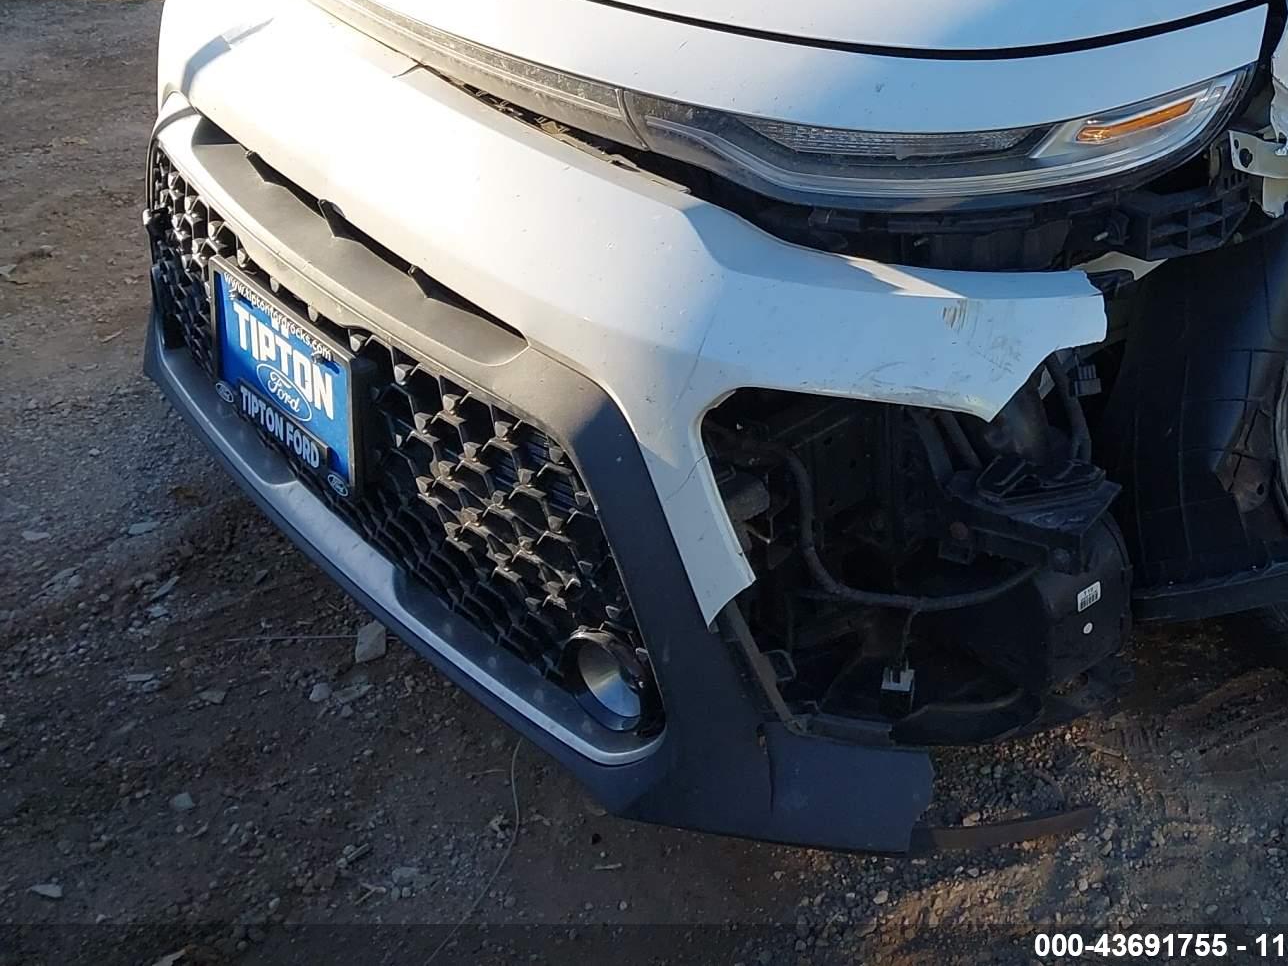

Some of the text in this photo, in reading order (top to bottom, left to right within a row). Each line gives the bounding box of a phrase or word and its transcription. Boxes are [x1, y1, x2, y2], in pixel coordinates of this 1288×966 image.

[223, 271, 332, 362] www.tiptonfordrocks.com
[233, 301, 334, 420] TIPTON
[267, 370, 301, 414] Ford
[240, 385, 320, 469] TIPTON FORD
